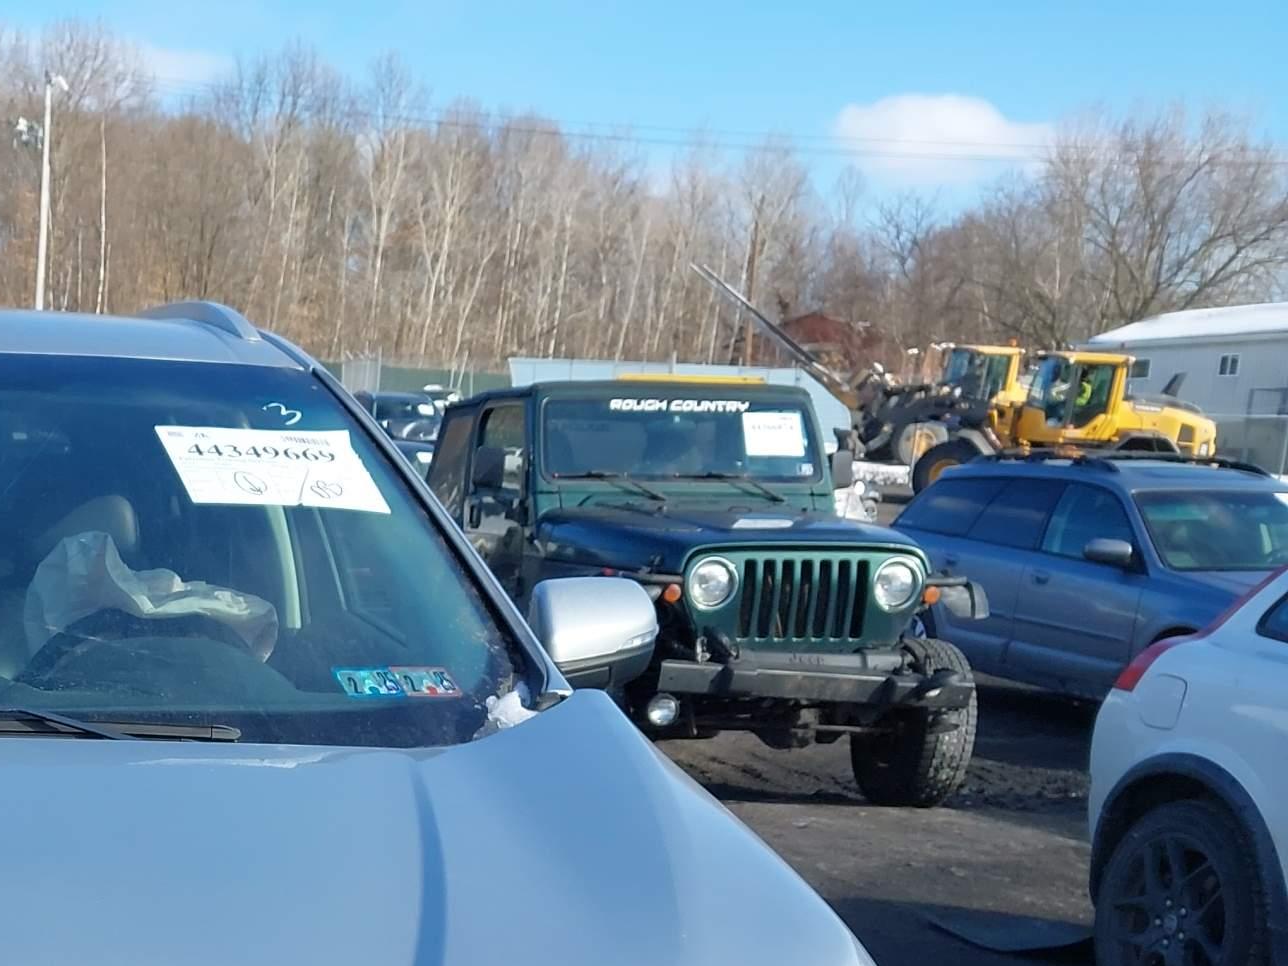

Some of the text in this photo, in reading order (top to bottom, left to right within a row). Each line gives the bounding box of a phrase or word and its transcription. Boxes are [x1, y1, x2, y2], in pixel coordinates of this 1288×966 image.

[262, 402, 302, 425] 3
[609, 398, 750, 412] ROUGH COUNTRY
[187, 443, 336, 463] 44349669
